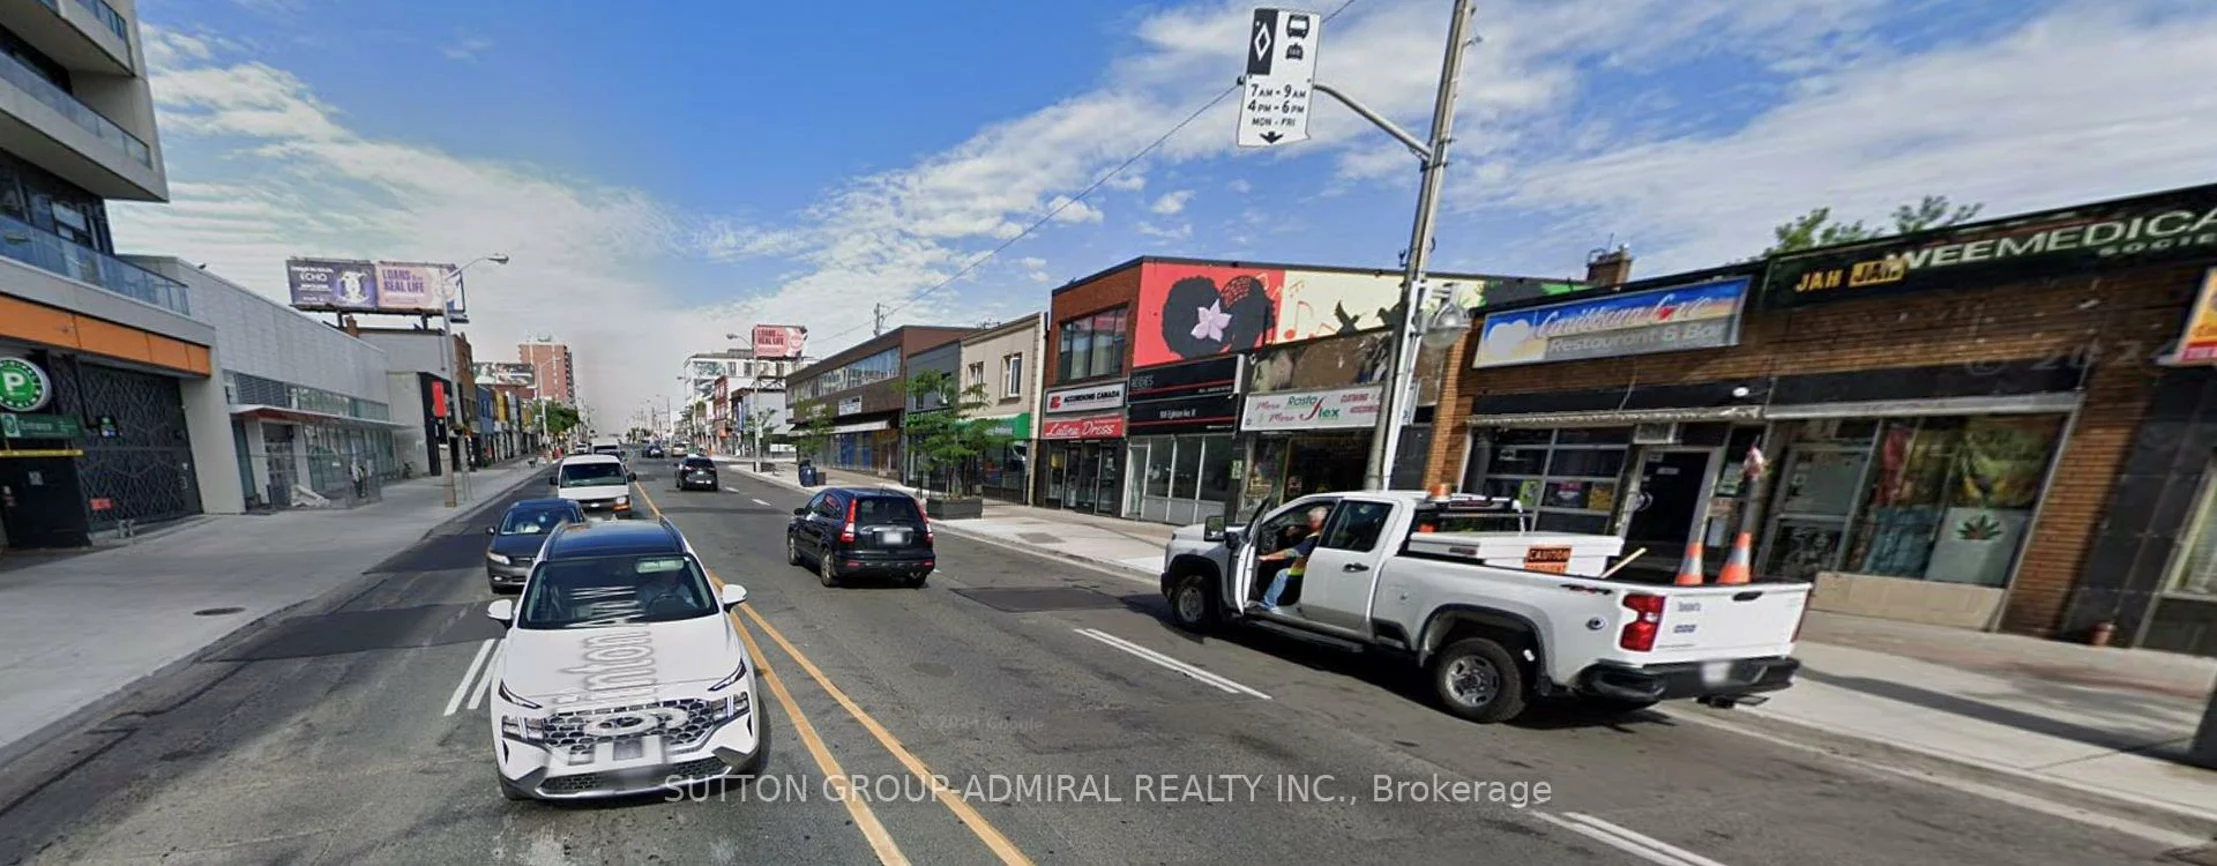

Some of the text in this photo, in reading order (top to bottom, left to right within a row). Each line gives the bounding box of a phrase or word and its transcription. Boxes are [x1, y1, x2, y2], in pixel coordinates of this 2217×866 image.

[1252, 117, 1272, 126] MON
[1281, 117, 1296, 126] FRI
[382, 269, 411, 281] LOANS
[1794, 269, 1843, 292] JAH
[384, 280, 424, 293] REAL LIFE
[1551, 322, 1727, 354] Restaurant & Bar
[3, 372, 25, 391] P
[1287, 396, 1318, 406] Rasta
[1082, 420, 1115, 436] Dress
